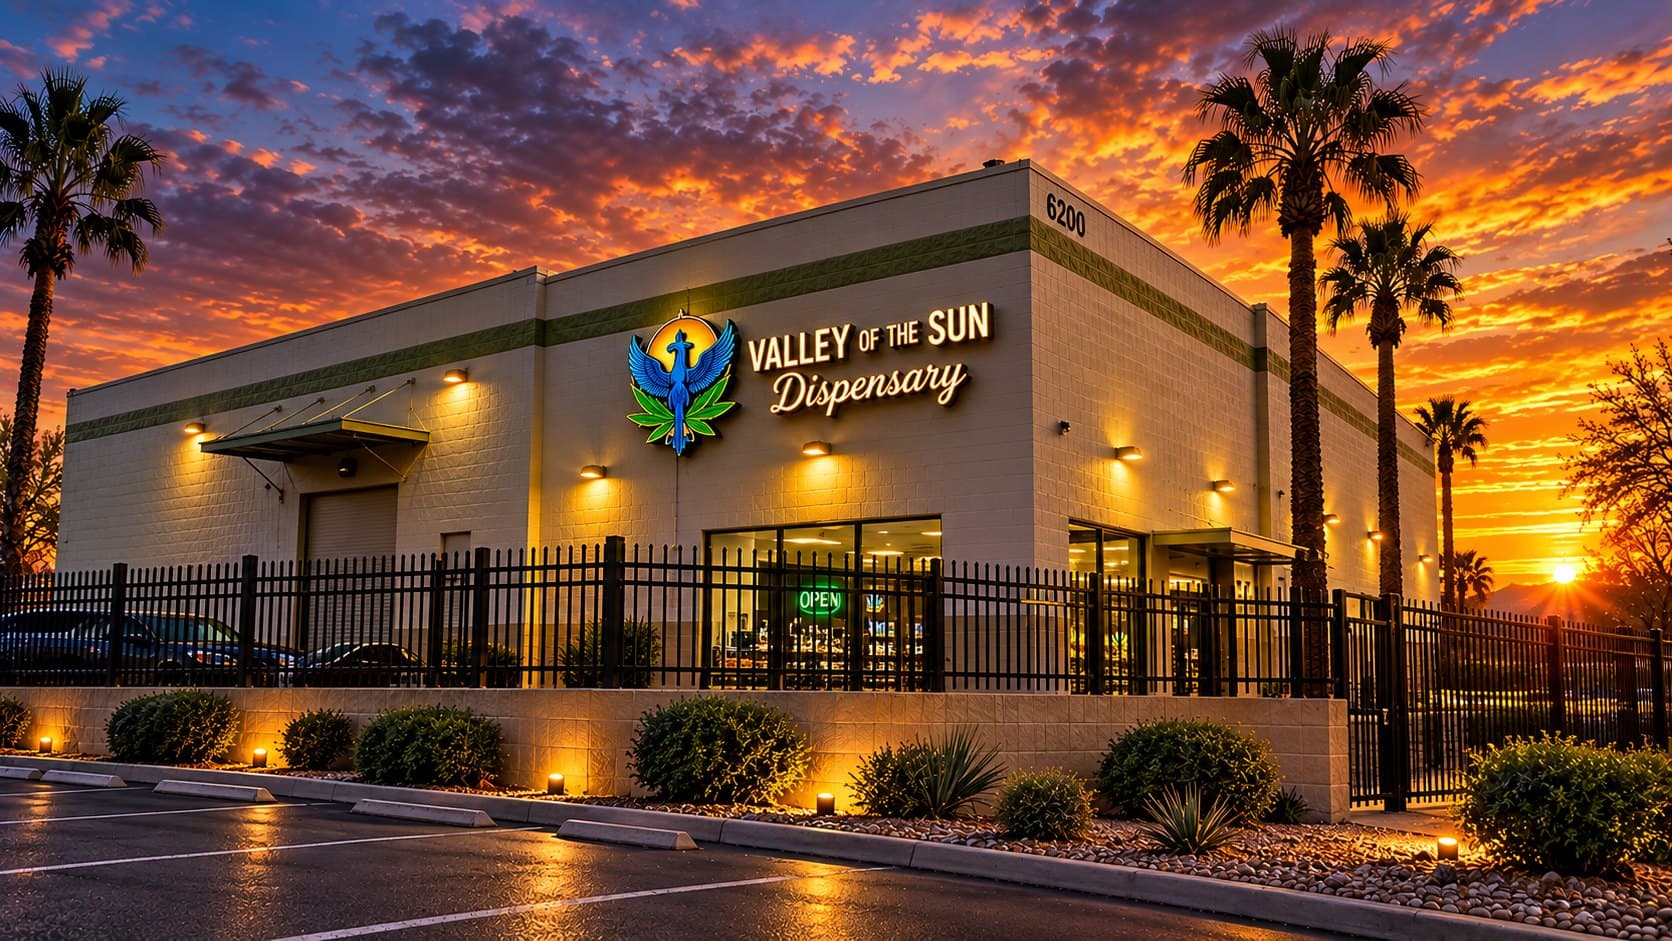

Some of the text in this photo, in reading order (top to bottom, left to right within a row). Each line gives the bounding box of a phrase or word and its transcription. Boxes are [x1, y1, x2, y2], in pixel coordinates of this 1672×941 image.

[1046, 193, 1085, 238] 6200
[748, 302, 989, 372] VALLEY OF THE SUN
[770, 363, 968, 417] Dispensary
[800, 591, 838, 608] OPEN
